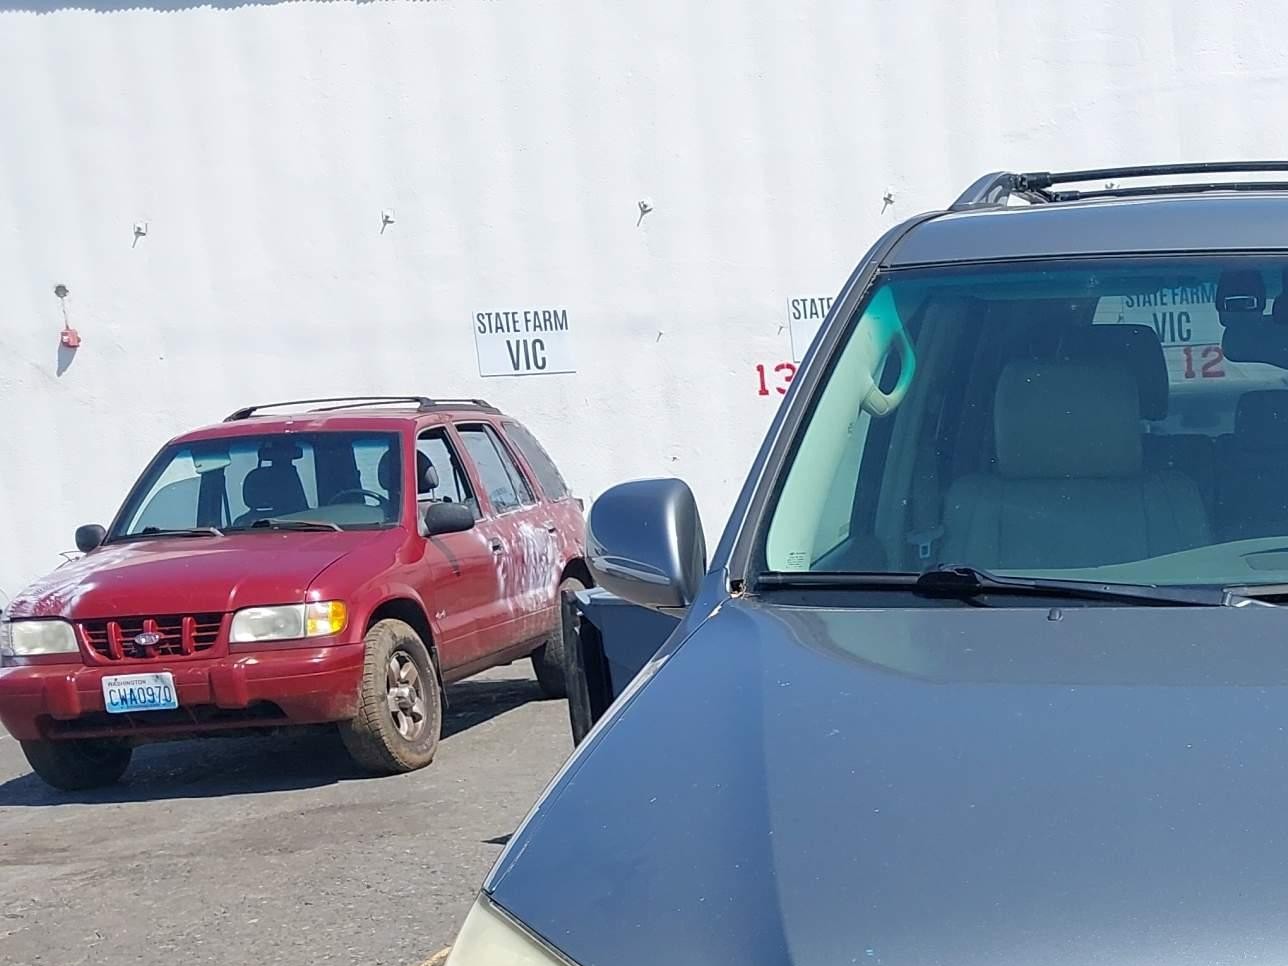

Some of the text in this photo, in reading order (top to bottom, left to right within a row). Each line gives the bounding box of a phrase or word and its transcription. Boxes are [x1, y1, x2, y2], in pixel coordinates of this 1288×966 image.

[1125, 282, 1217, 308] STATE FARM
[476, 309, 569, 335] STATE FARM
[1152, 311, 1192, 343] VIC
[505, 338, 547, 371] VIC
[1183, 346, 1226, 379] 12
[756, 362, 798, 396] 13
[108, 685, 172, 707] CWA0970
